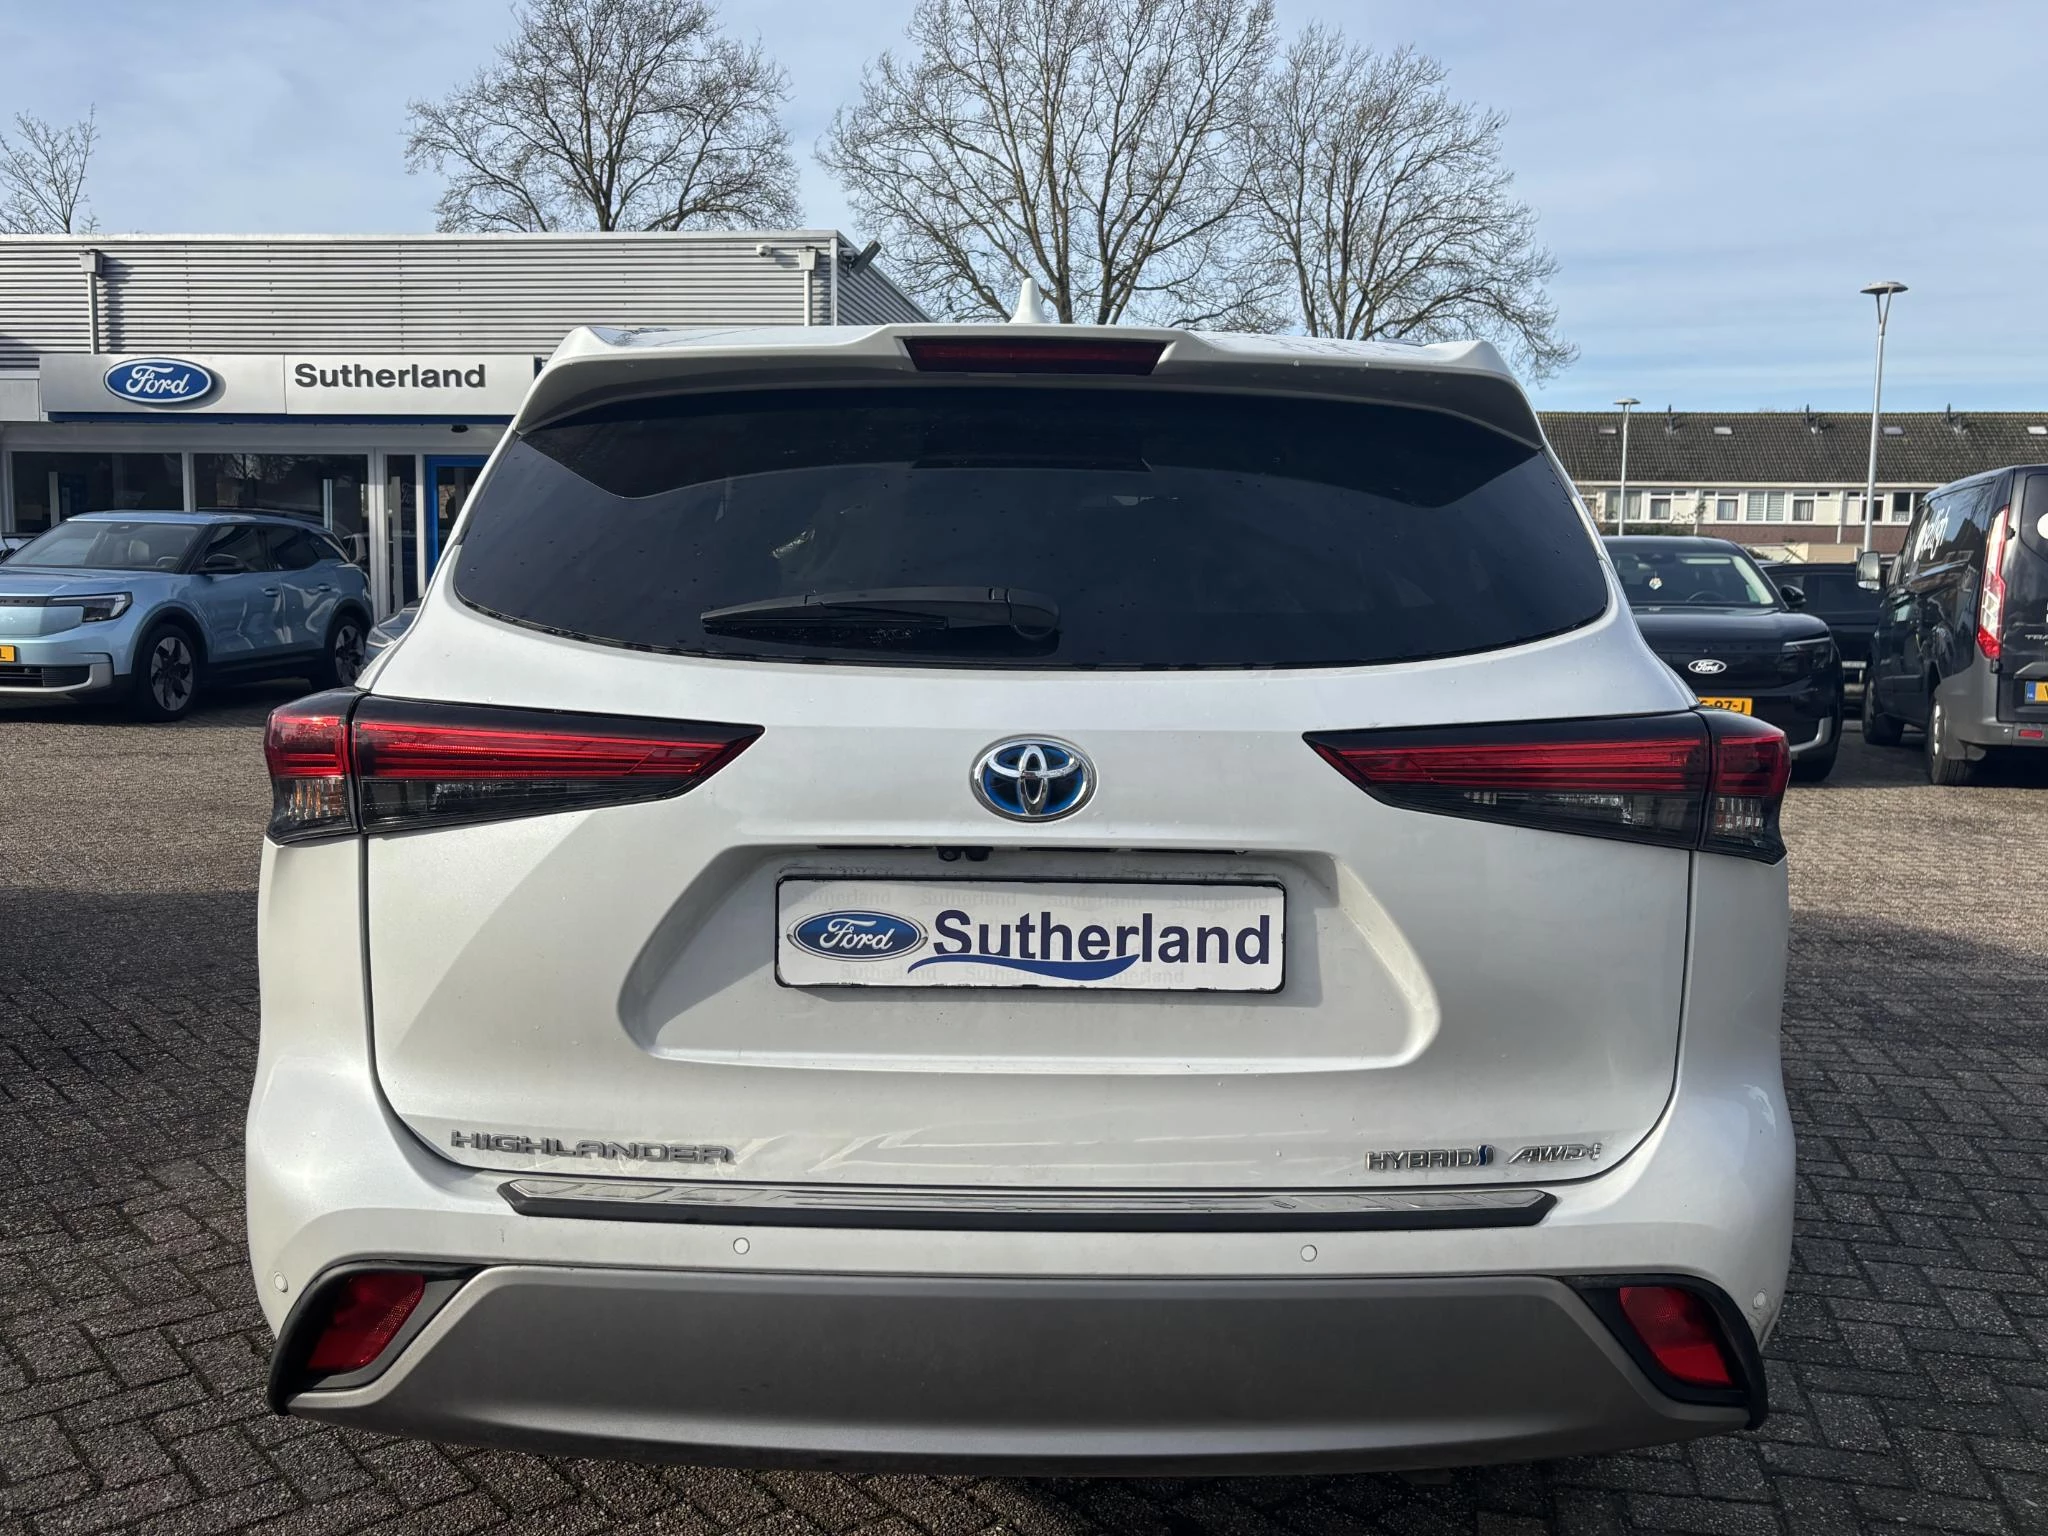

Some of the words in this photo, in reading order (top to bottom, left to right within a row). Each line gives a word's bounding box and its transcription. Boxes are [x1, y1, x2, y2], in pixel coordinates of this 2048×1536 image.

[125, 365, 190, 396] Ford
[294, 363, 486, 388] Sutherland
[819, 918, 895, 950] Ford
[933, 909, 1270, 965] Sutherland
[451, 1130, 734, 1164] HIGHLANDER
[1367, 1150, 1472, 1170] HYBRID
